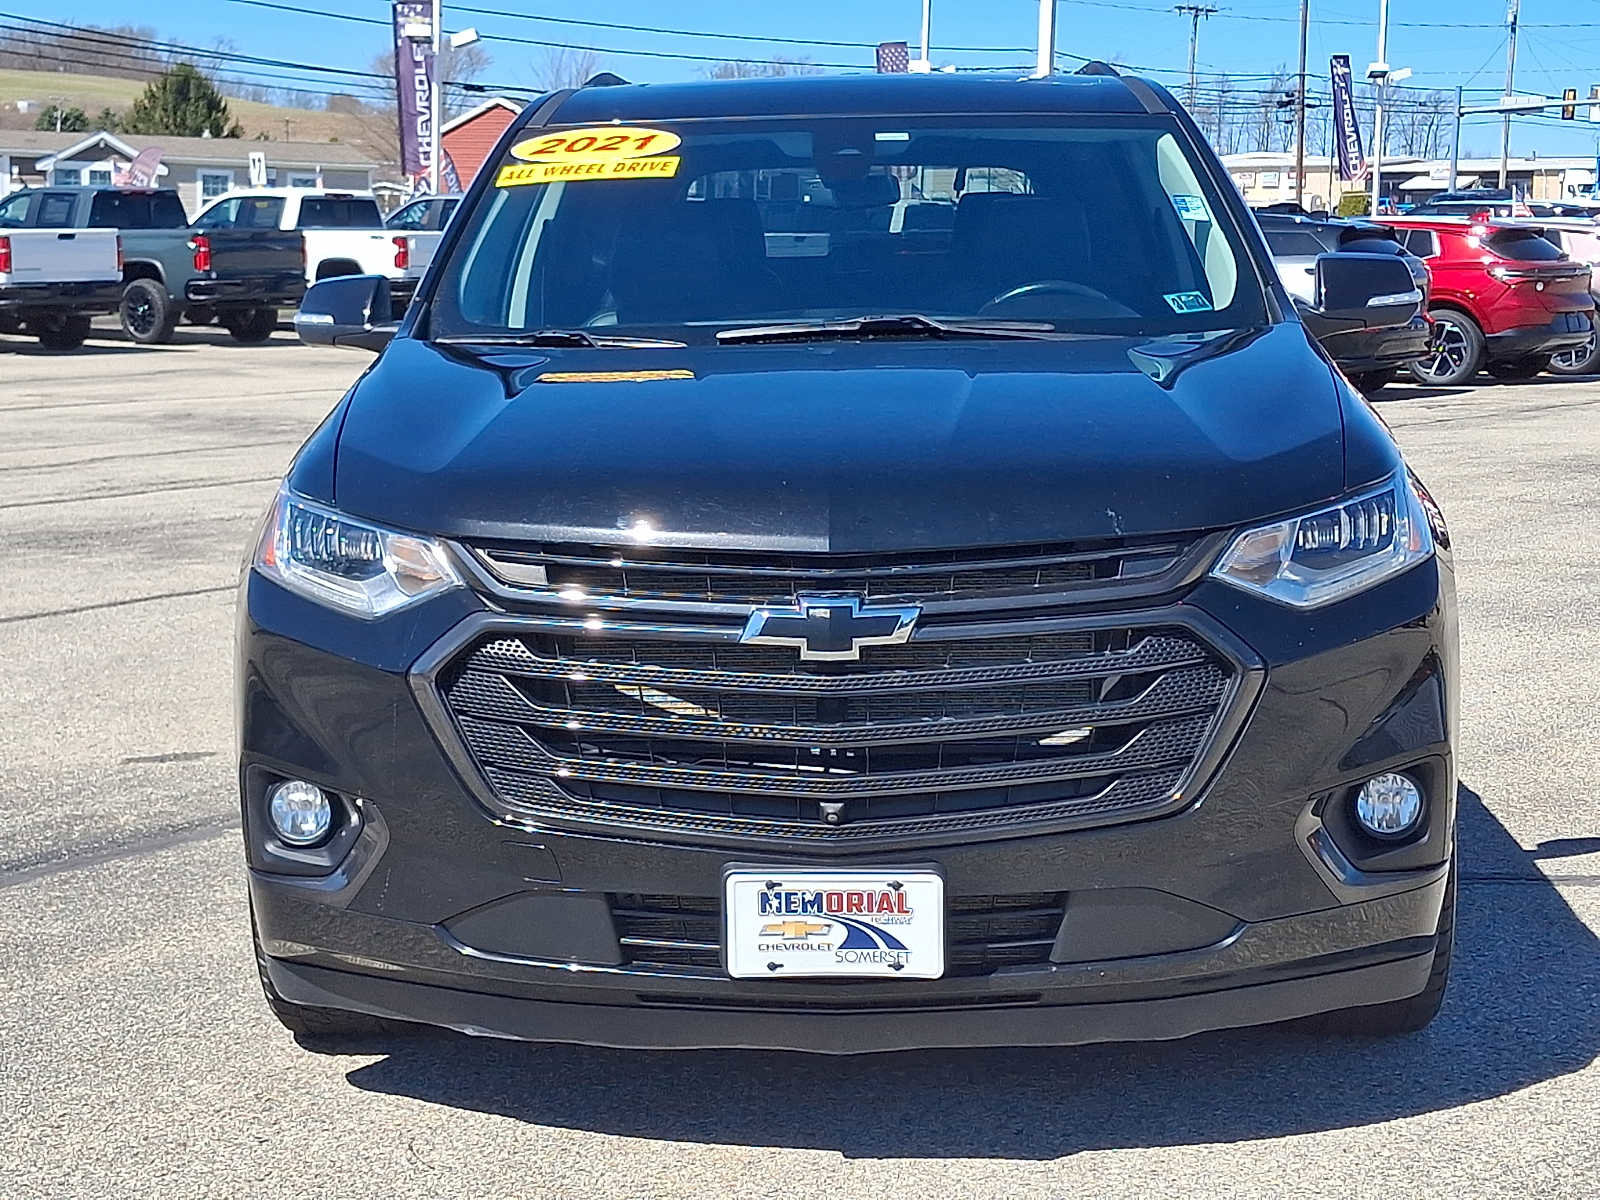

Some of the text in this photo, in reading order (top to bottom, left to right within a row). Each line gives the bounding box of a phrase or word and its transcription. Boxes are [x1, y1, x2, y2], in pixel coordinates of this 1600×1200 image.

[412, 43, 432, 167] CHEVROLE
[529, 134, 658, 156] 2021
[503, 161, 672, 181] ALL WHEEL DRIVE
[759, 890, 912, 915] MEMORIAL
[758, 943, 834, 951] CHEVROLET
[835, 951, 912, 963] SOMERSET
